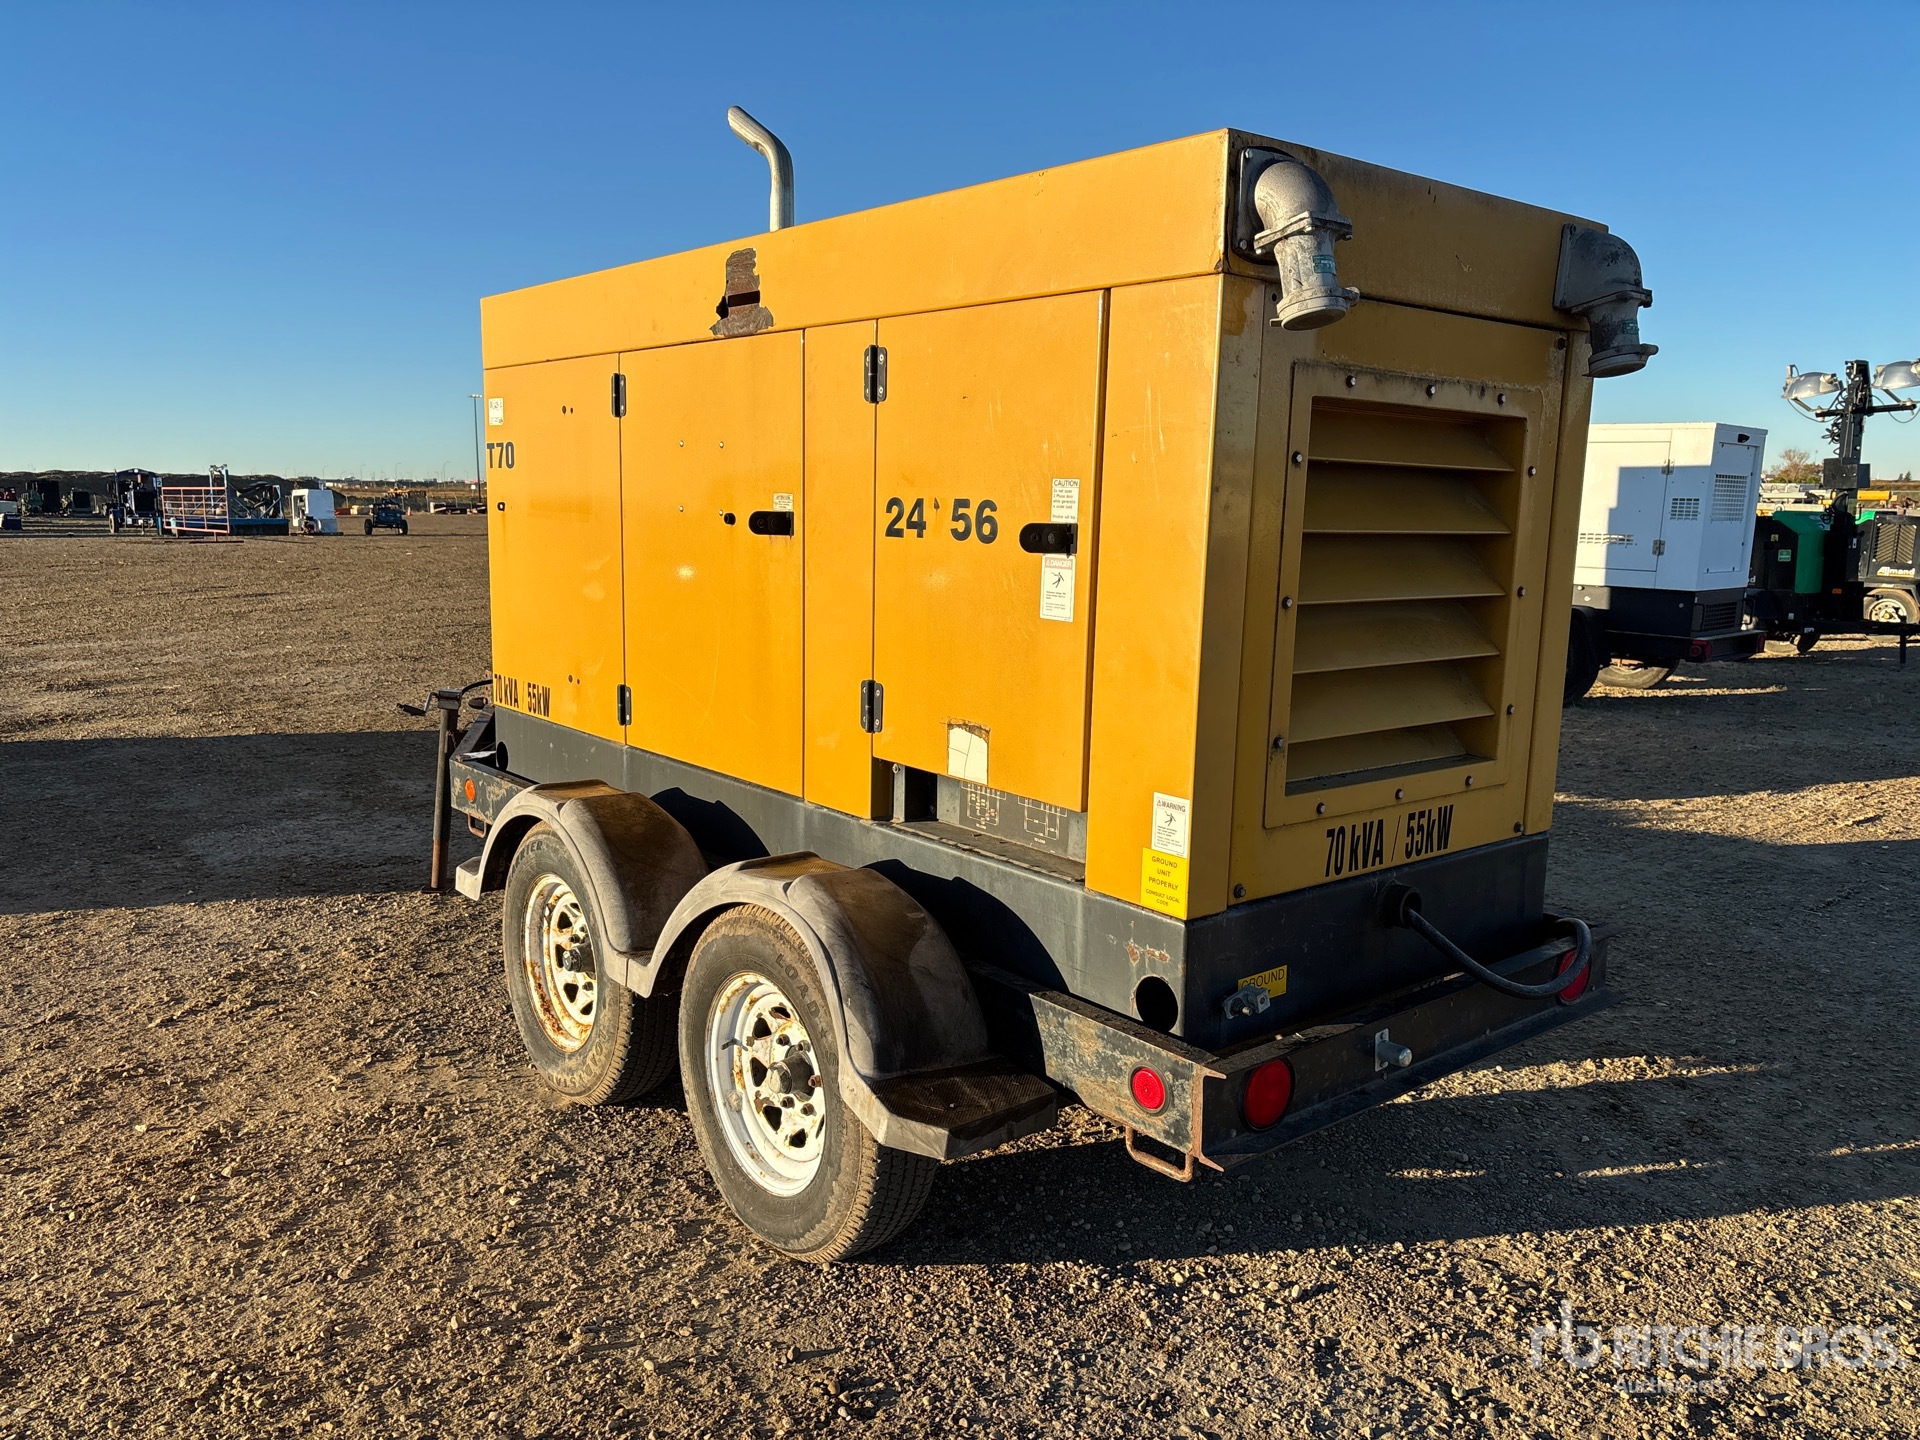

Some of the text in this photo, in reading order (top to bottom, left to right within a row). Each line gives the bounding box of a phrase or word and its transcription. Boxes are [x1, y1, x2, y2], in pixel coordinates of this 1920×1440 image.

[486, 441, 515, 469] T70
[885, 497, 998, 544] 24 56
[1050, 559, 1072, 568] DANGER
[494, 673, 503, 704] 70
[527, 682, 551, 718] 55kW
[1161, 801, 1186, 812] WARNING
[1325, 825, 1346, 878] 70
[1348, 818, 1384, 872] kVA
[1405, 804, 1455, 860] 55kW
[1151, 855, 1178, 868] GROUND
[1157, 868, 1171, 877] UNIT
[1148, 876, 1179, 891] PROPERLY
[1145, 888, 1180, 903] CONSULT LOCAL
[1156, 898, 1169, 907] CODE
